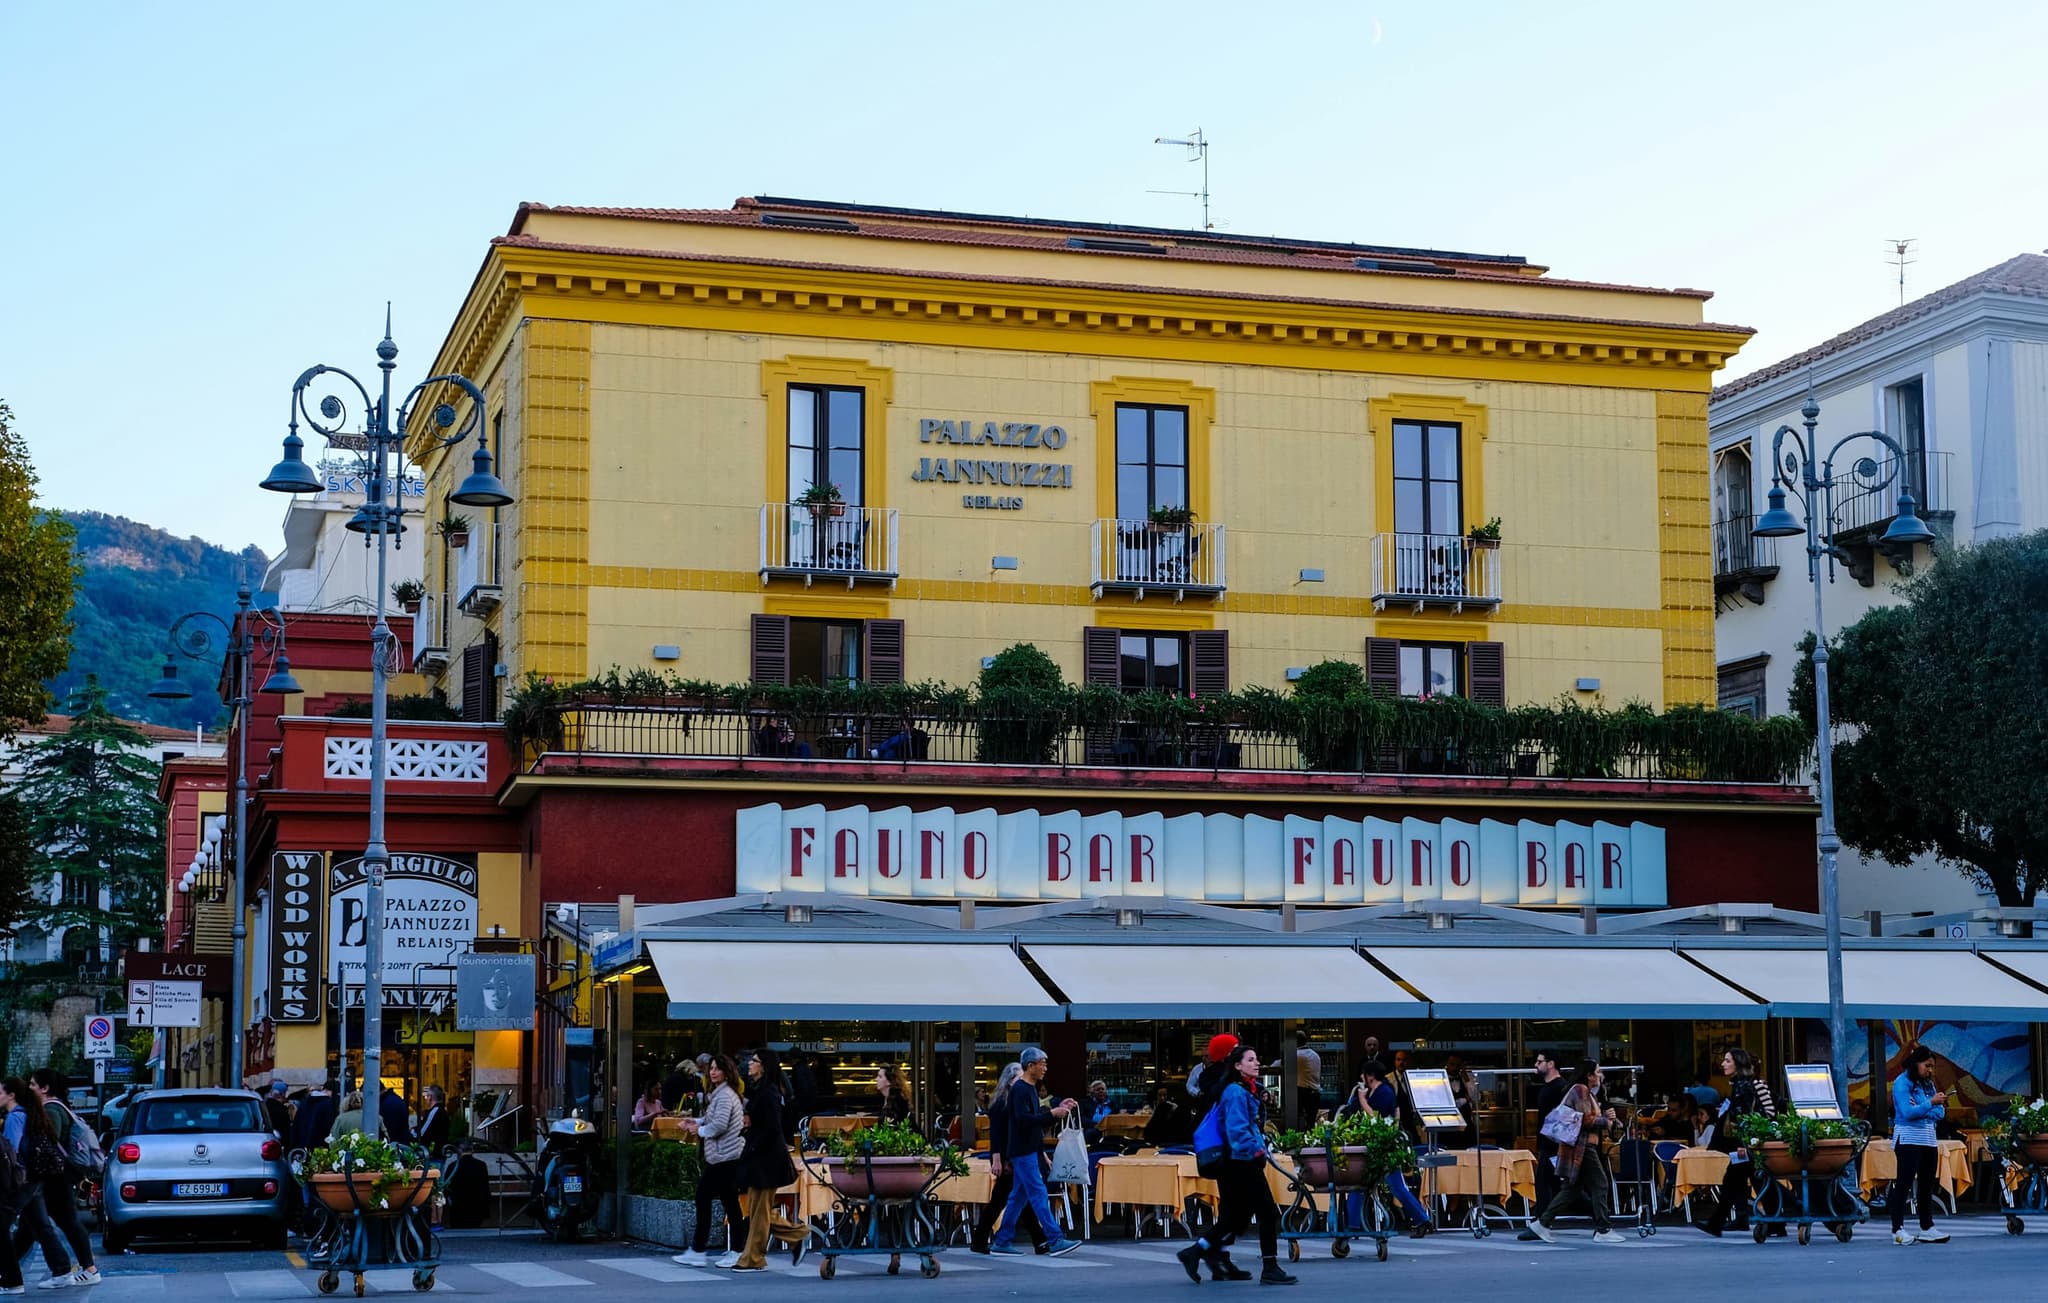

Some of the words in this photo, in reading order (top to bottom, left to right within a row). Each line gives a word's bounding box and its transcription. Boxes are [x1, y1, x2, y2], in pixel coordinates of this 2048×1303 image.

[920, 418, 1068, 450] PALAZZO
[912, 457, 1073, 488] JANNUZZI
[962, 495, 1024, 510] RELAIS
[790, 827, 987, 880] FAUNO
[1047, 832, 1155, 883] BAR
[1293, 837, 1471, 887] FAUNO
[1526, 841, 1623, 889] BAR
[358, 856, 474, 886] GRGIULO
[282, 855, 313, 923] WOOD
[386, 899, 466, 911] PALAZZO
[382, 917, 470, 930] JANNUZZI
[397, 938, 453, 948] RELAIS
[162, 963, 207, 977] LACE
[280, 932, 312, 1018] WORKS
[180, 1185, 190, 1193] EZ
